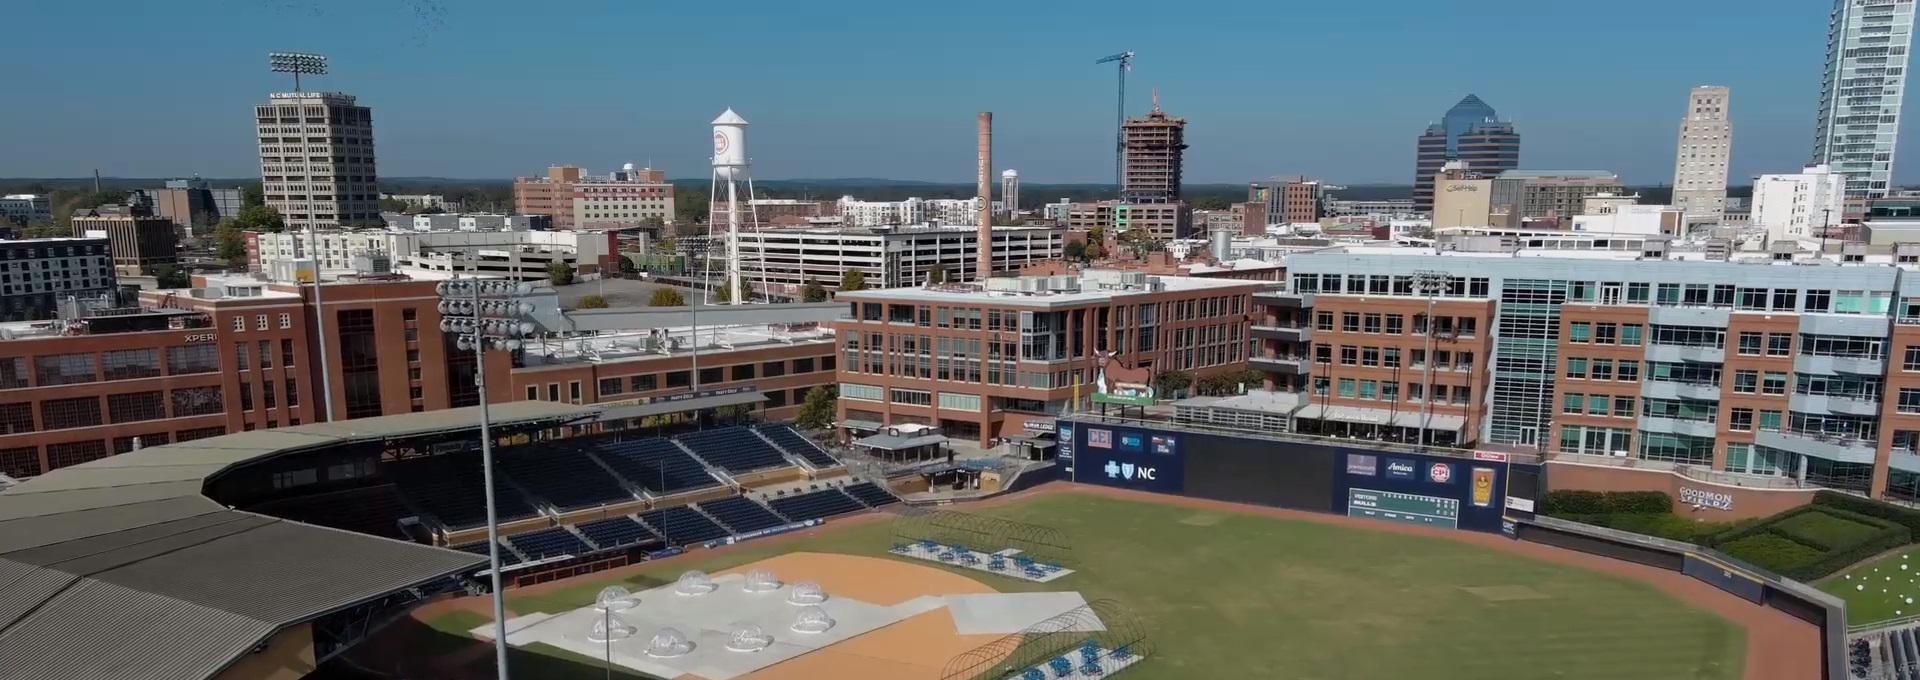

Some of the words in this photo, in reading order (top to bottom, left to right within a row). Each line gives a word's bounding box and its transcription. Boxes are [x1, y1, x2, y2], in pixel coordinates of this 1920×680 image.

[184, 333, 217, 342] XPERI
[1090, 430, 1111, 444] CEI
[1388, 462, 1412, 472] Amica
[1138, 467, 1156, 480] NC
[1680, 487, 1732, 502] GOODMON
[1687, 496, 1720, 506] FIELD
